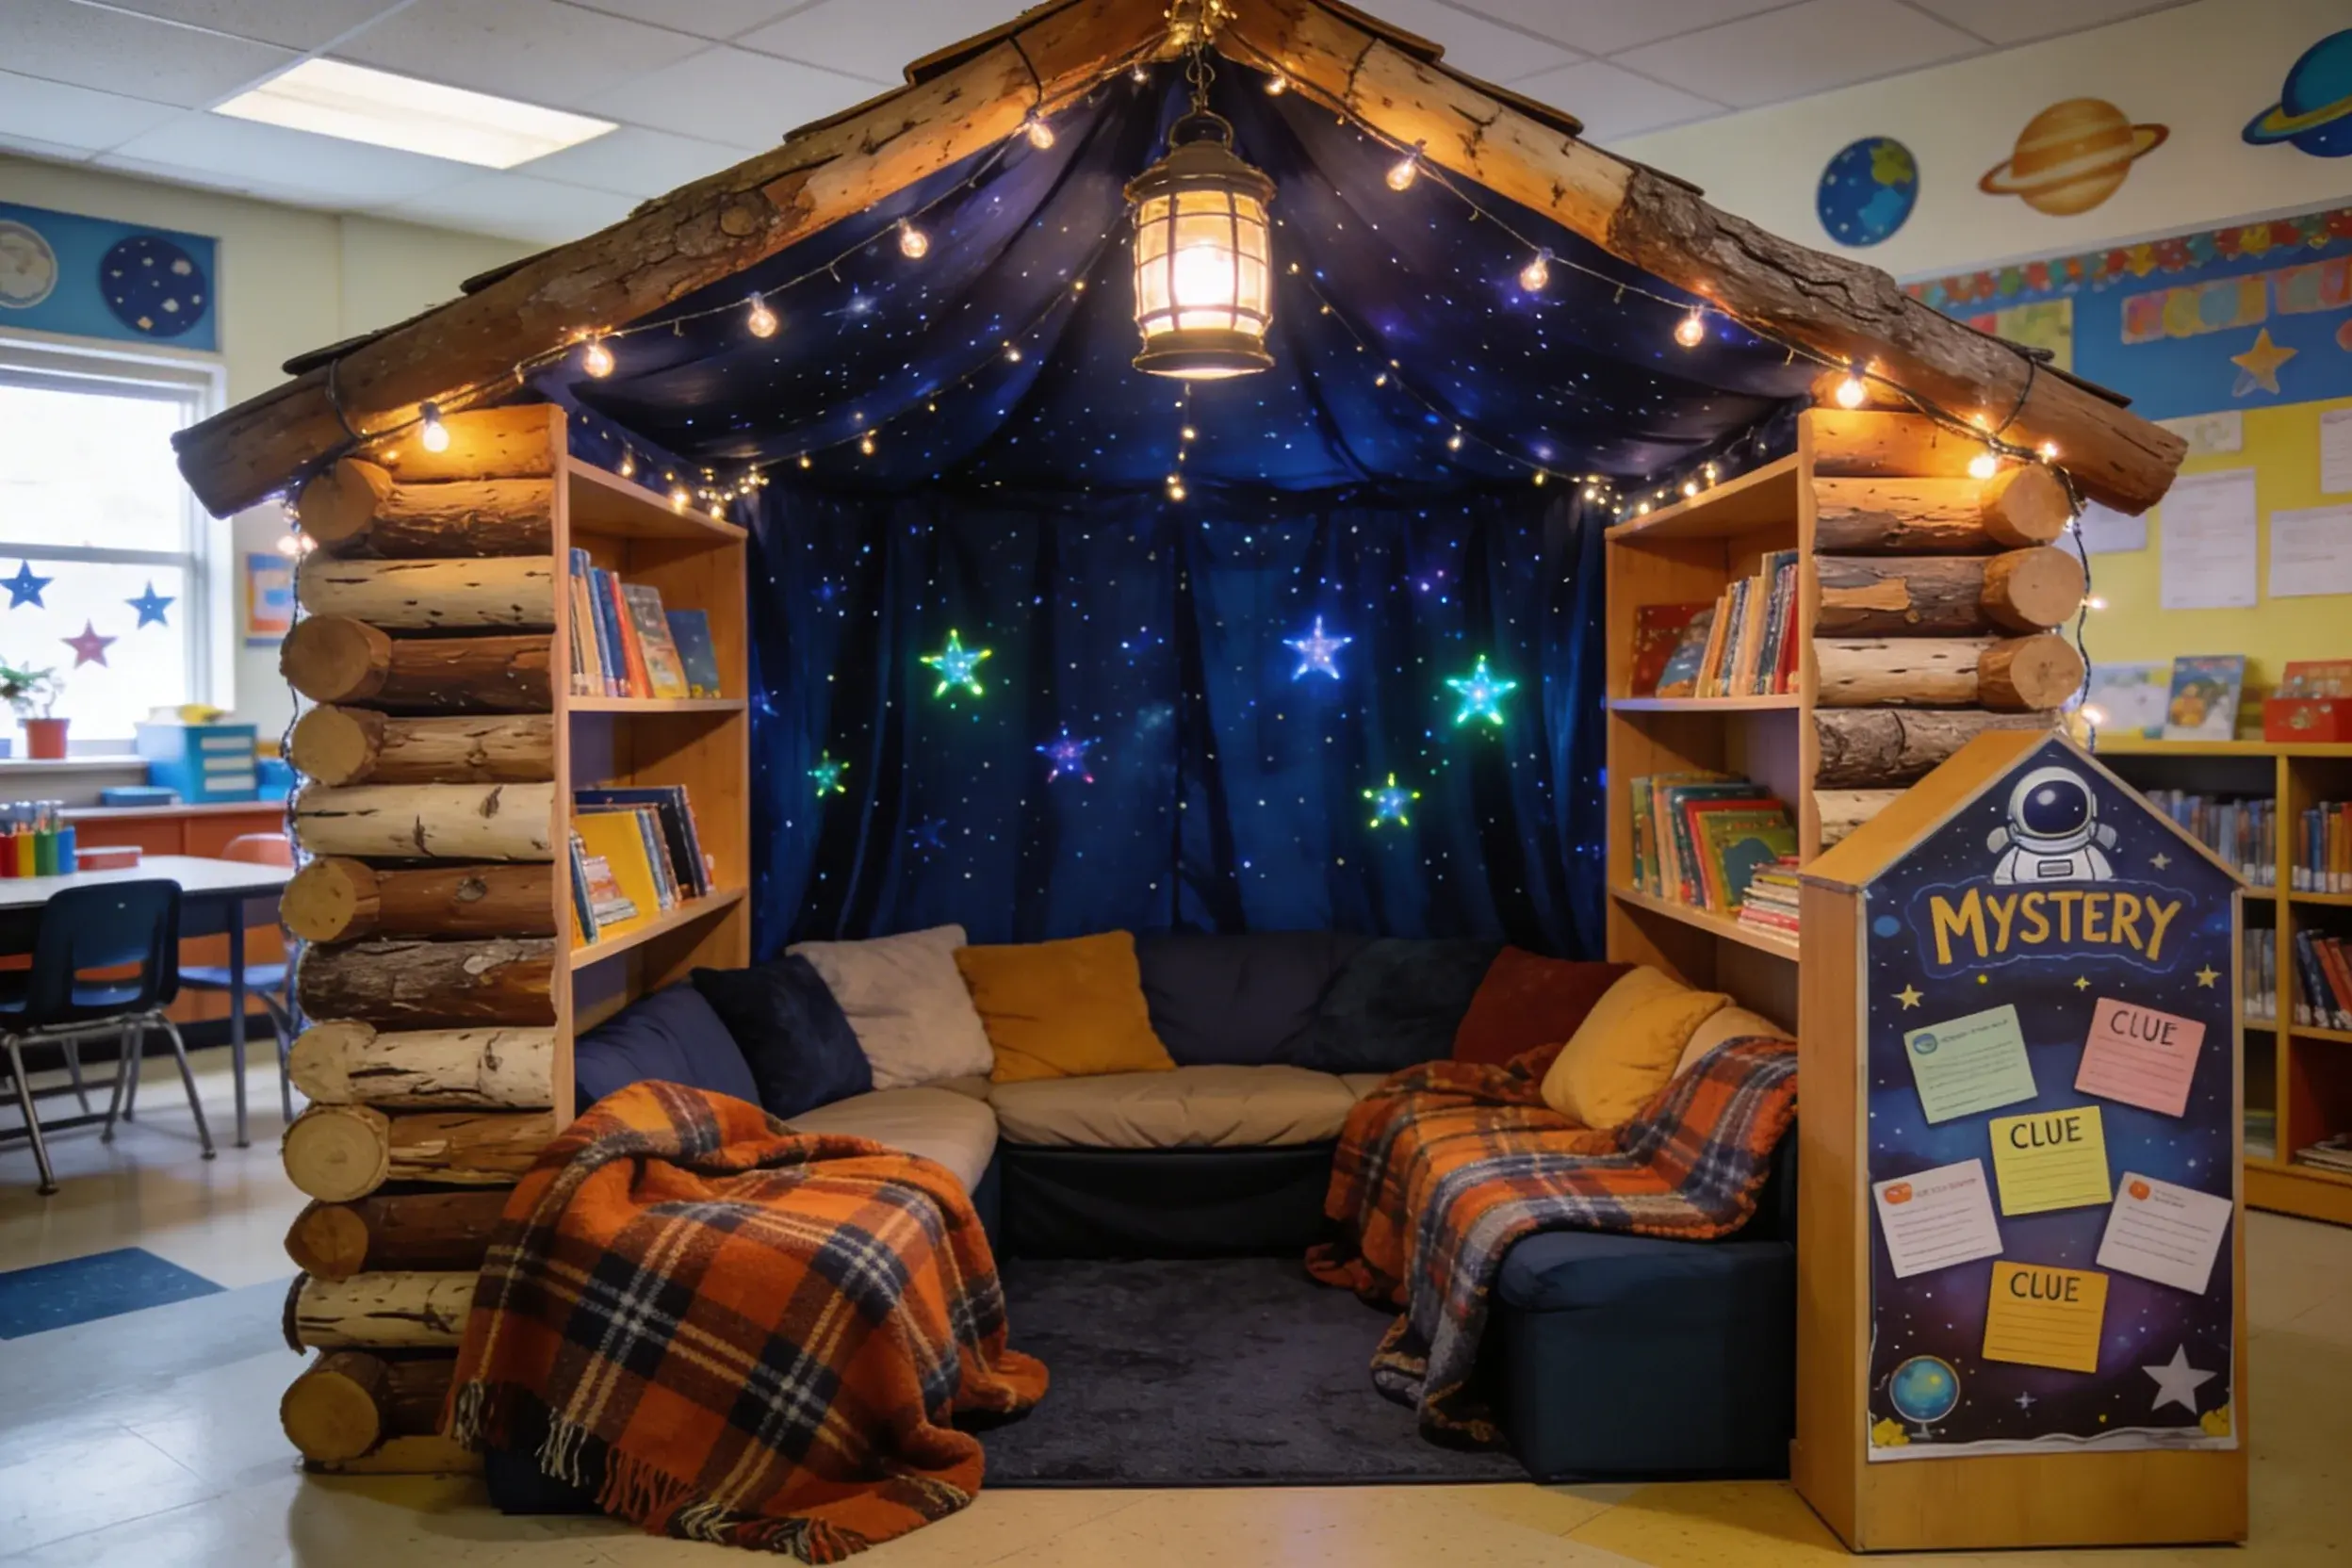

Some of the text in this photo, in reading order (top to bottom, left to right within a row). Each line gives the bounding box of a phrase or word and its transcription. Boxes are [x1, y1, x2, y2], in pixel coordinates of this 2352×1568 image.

[1930, 888, 2181, 964] MYSTERY
[2110, 1010, 2178, 1045] CLUE
[2010, 1116, 2083, 1150] CLUE
[2009, 1271, 2081, 1301] CLUE
